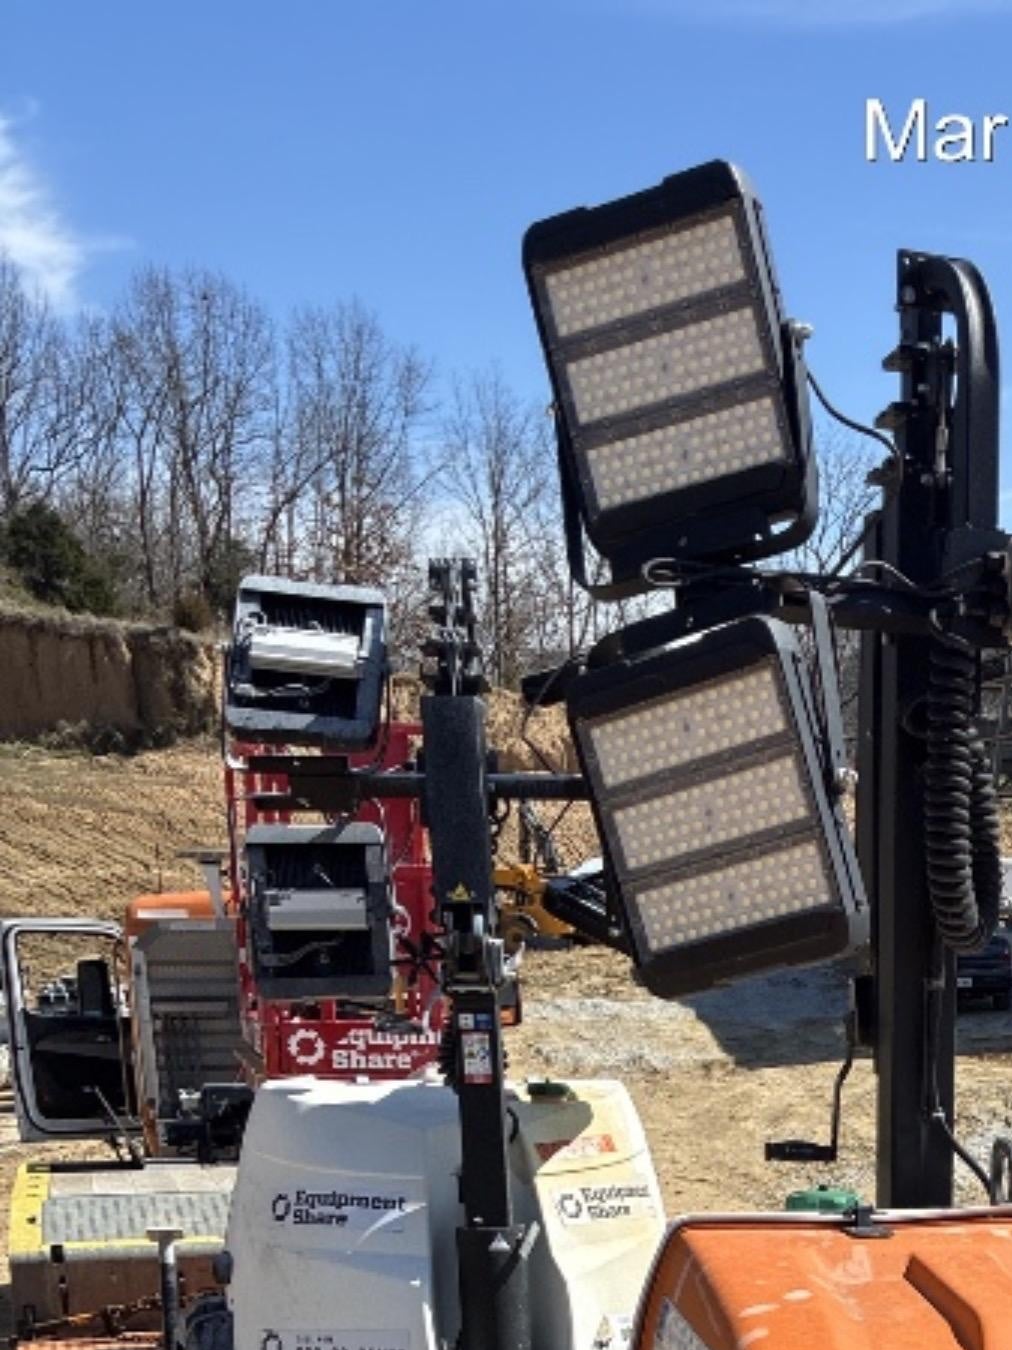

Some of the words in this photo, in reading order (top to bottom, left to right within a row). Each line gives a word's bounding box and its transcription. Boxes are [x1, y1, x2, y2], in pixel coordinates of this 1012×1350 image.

[332, 1049, 412, 1069] Share
[293, 1190, 407, 1210] Equipment
[292, 1208, 349, 1226] Share
